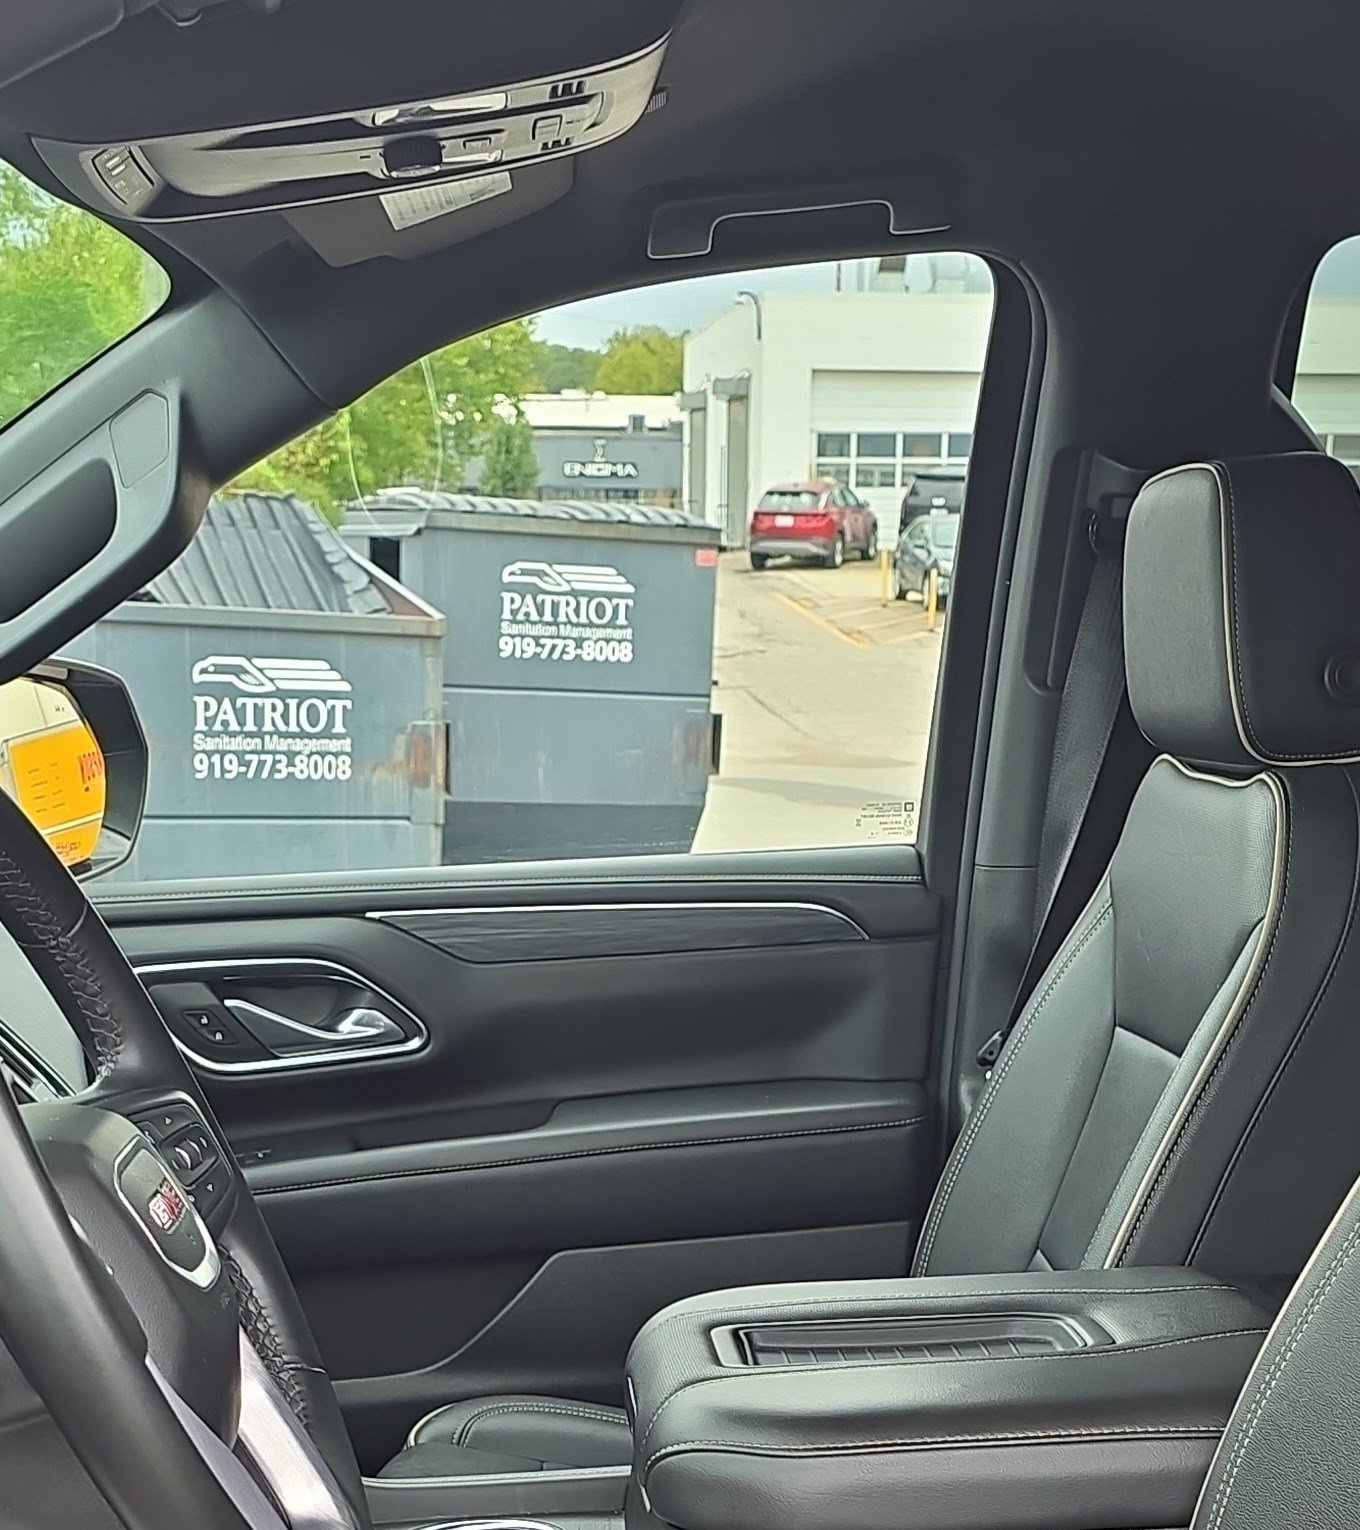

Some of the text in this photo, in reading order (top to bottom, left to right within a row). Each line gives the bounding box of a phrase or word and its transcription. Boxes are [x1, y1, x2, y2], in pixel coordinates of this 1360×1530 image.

[500, 591, 634, 626] PATRIOT
[498, 636, 634, 663] 919-773-8008
[192, 695, 353, 734] PATRIOT
[193, 733, 352, 755] Sanitation Management
[193, 752, 352, 780] 919-773-8008
